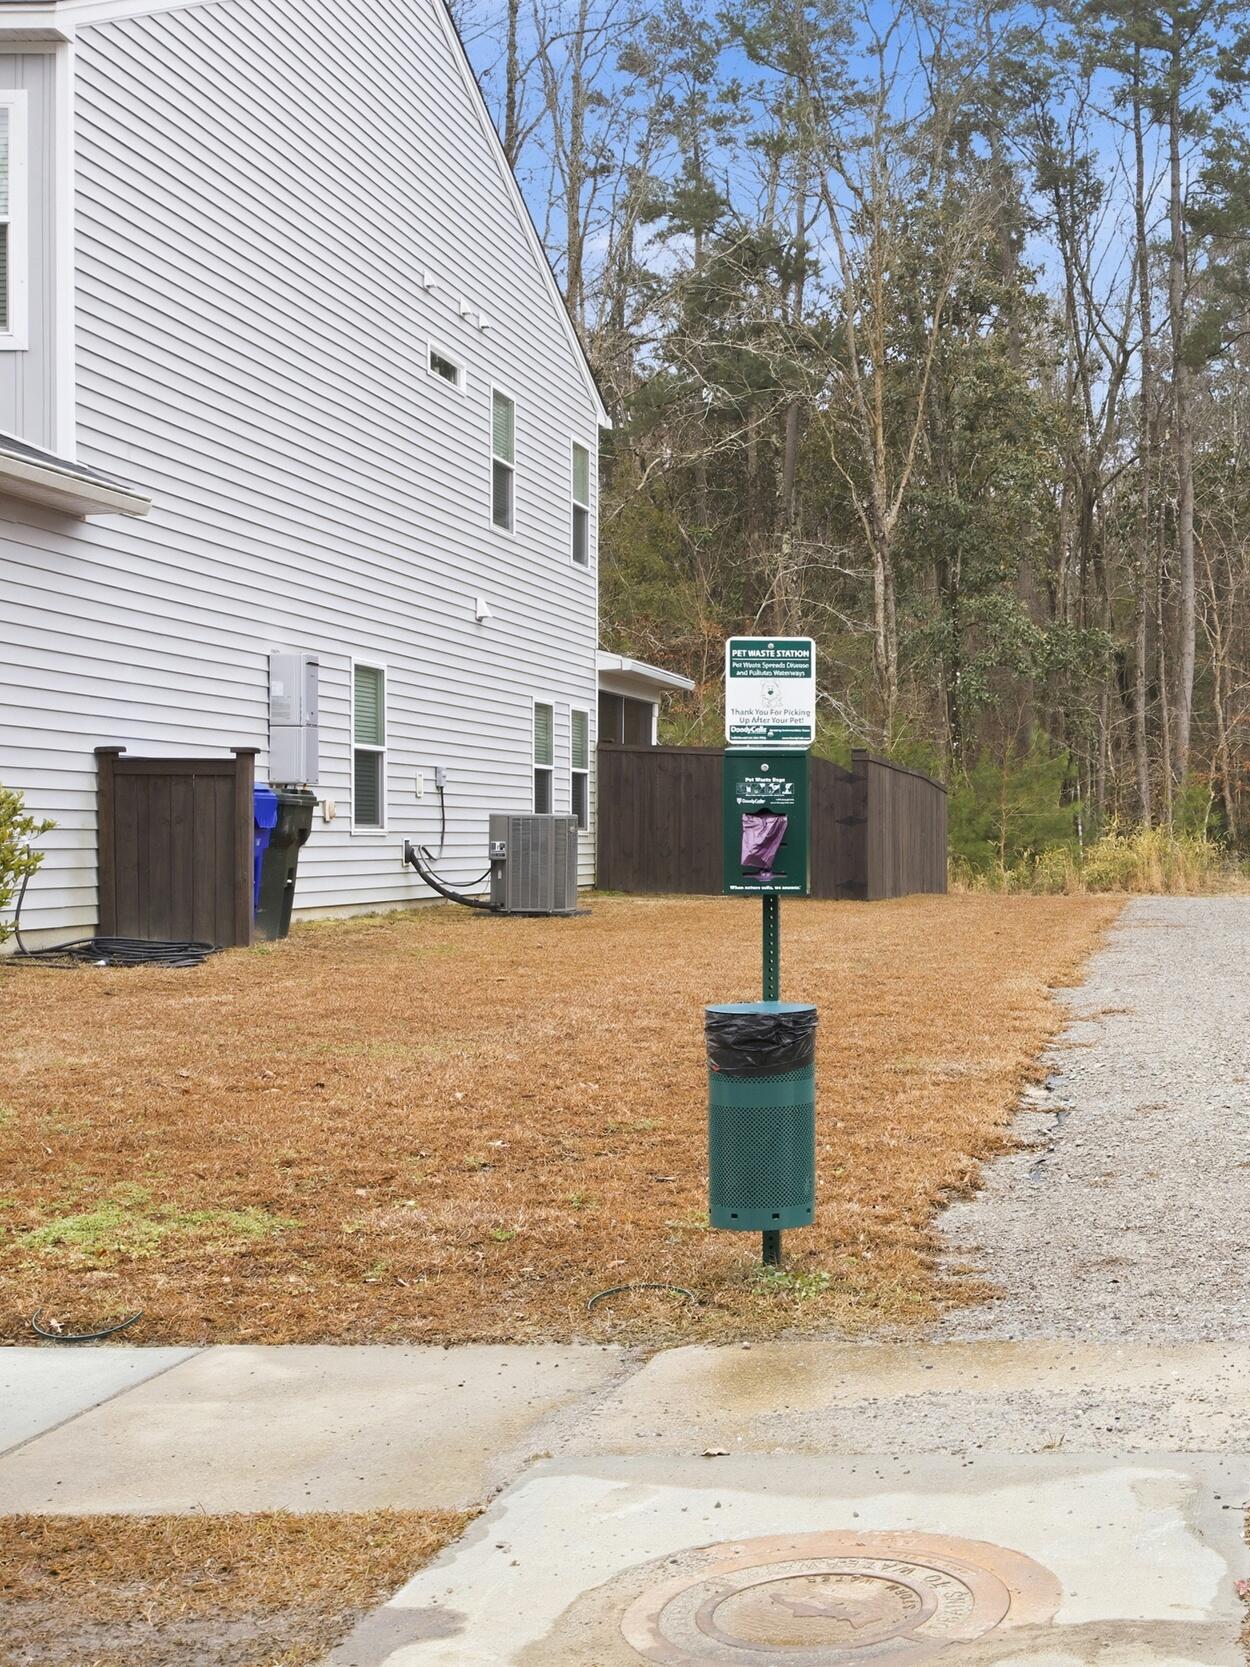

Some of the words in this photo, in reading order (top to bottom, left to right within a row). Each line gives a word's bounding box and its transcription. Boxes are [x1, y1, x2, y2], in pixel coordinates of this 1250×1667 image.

[776, 650, 809, 658] STATION
[762, 661, 785, 669] Spreads
[786, 661, 809, 669] Disease
[731, 708, 753, 716] Thank
[754, 708, 769, 716] You
[770, 708, 782, 716] For
[784, 708, 811, 717] Picking
[739, 717, 750, 725] Up
[751, 716, 770, 724] After
[806, 1574, 876, 1585] WATER
[924, 1574, 950, 1589] TO
[884, 1583, 917, 1610] STORM
